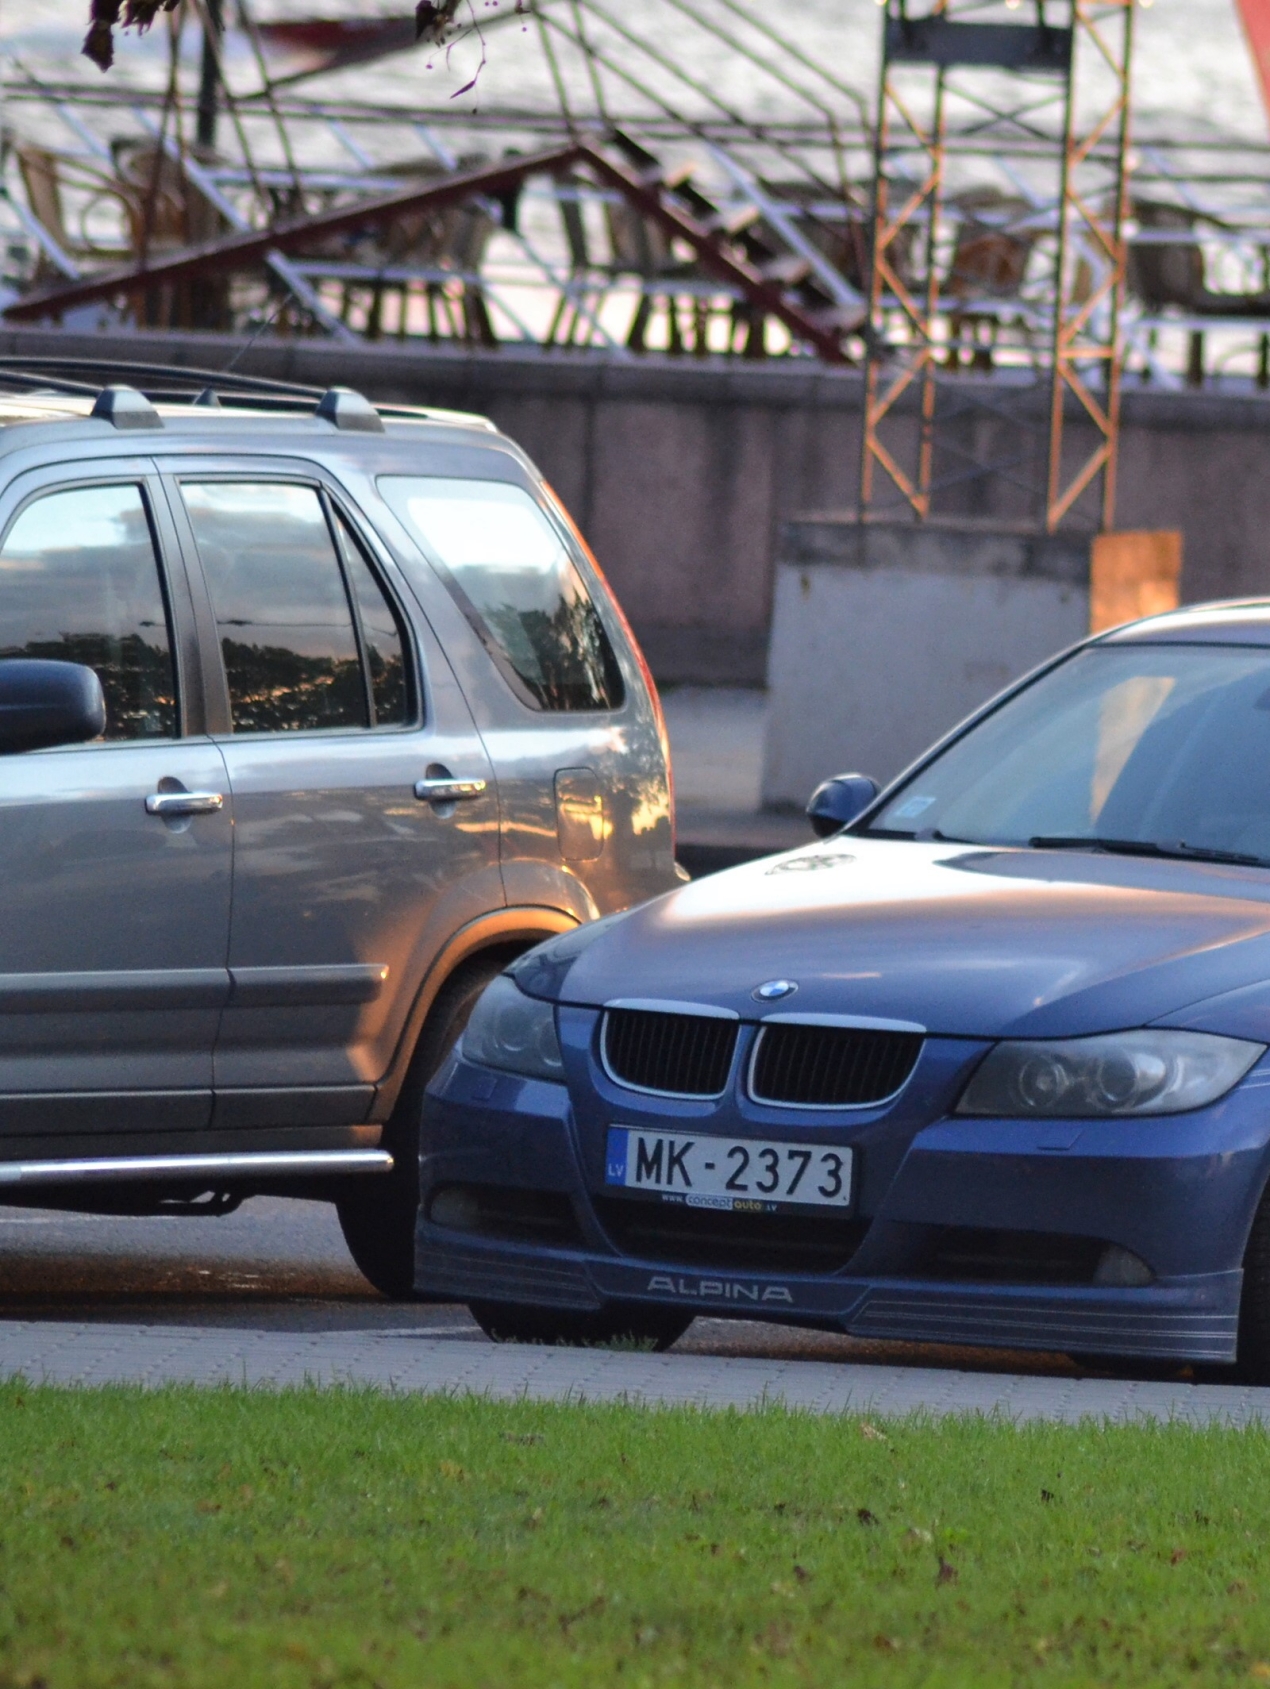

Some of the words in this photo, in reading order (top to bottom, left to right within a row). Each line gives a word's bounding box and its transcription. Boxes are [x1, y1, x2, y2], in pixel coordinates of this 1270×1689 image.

[607, 1163, 624, 1177] LV
[636, 1136, 843, 1198] MK-2373
[647, 1276, 793, 1303] ALPINA
